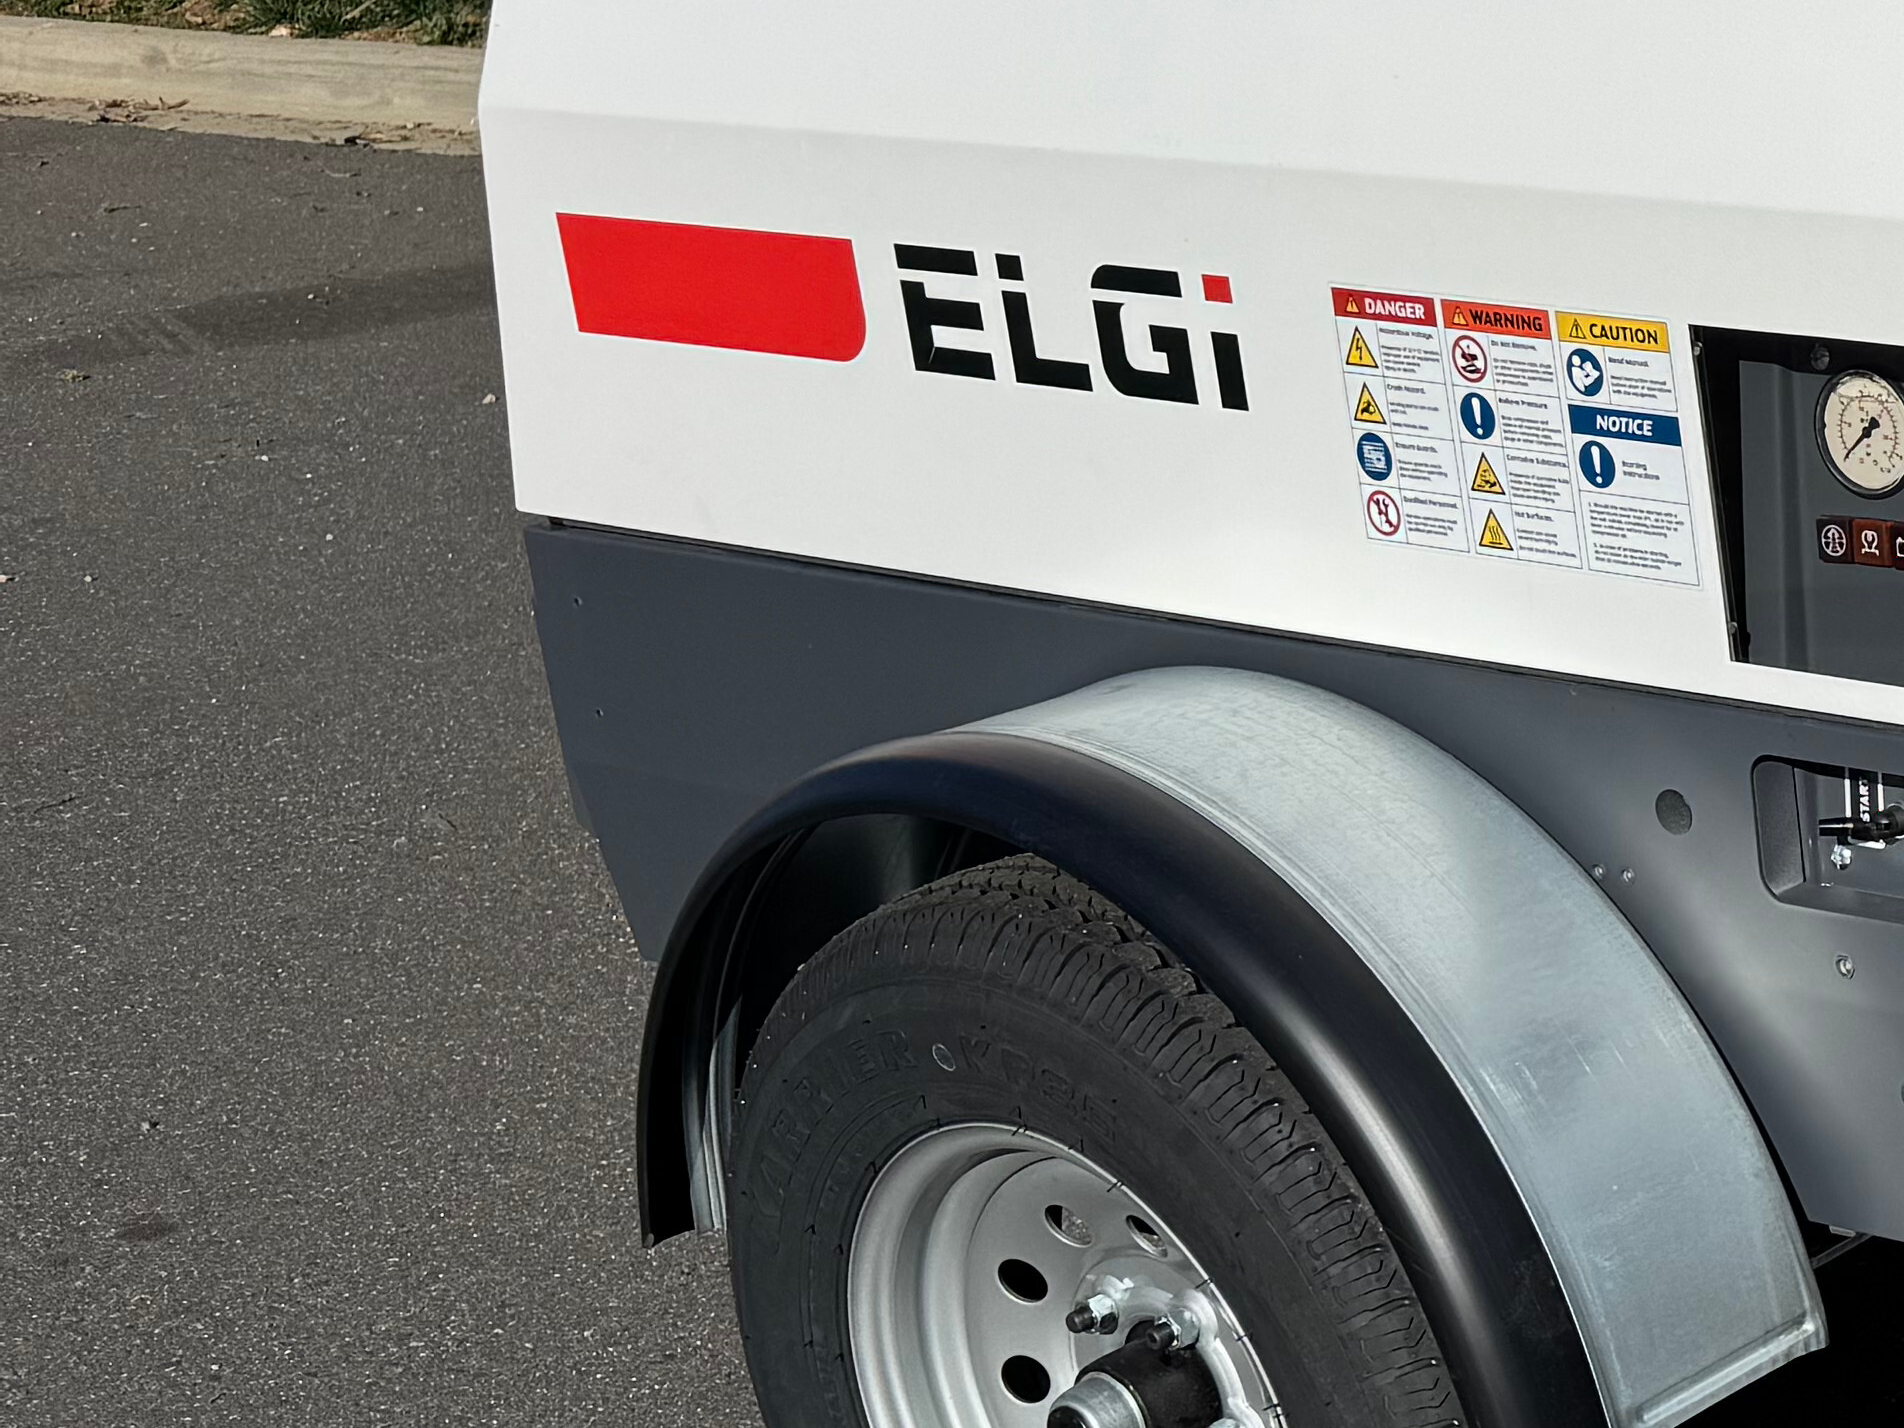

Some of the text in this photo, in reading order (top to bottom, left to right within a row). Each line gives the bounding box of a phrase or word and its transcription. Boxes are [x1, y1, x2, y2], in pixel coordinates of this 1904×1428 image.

[1364, 297, 1426, 321] DANGER
[1469, 308, 1543, 332] WARNING
[1589, 323, 1659, 345] CAUTION
[1596, 414, 1653, 437] NOTICE
[1858, 776, 1871, 823] START
